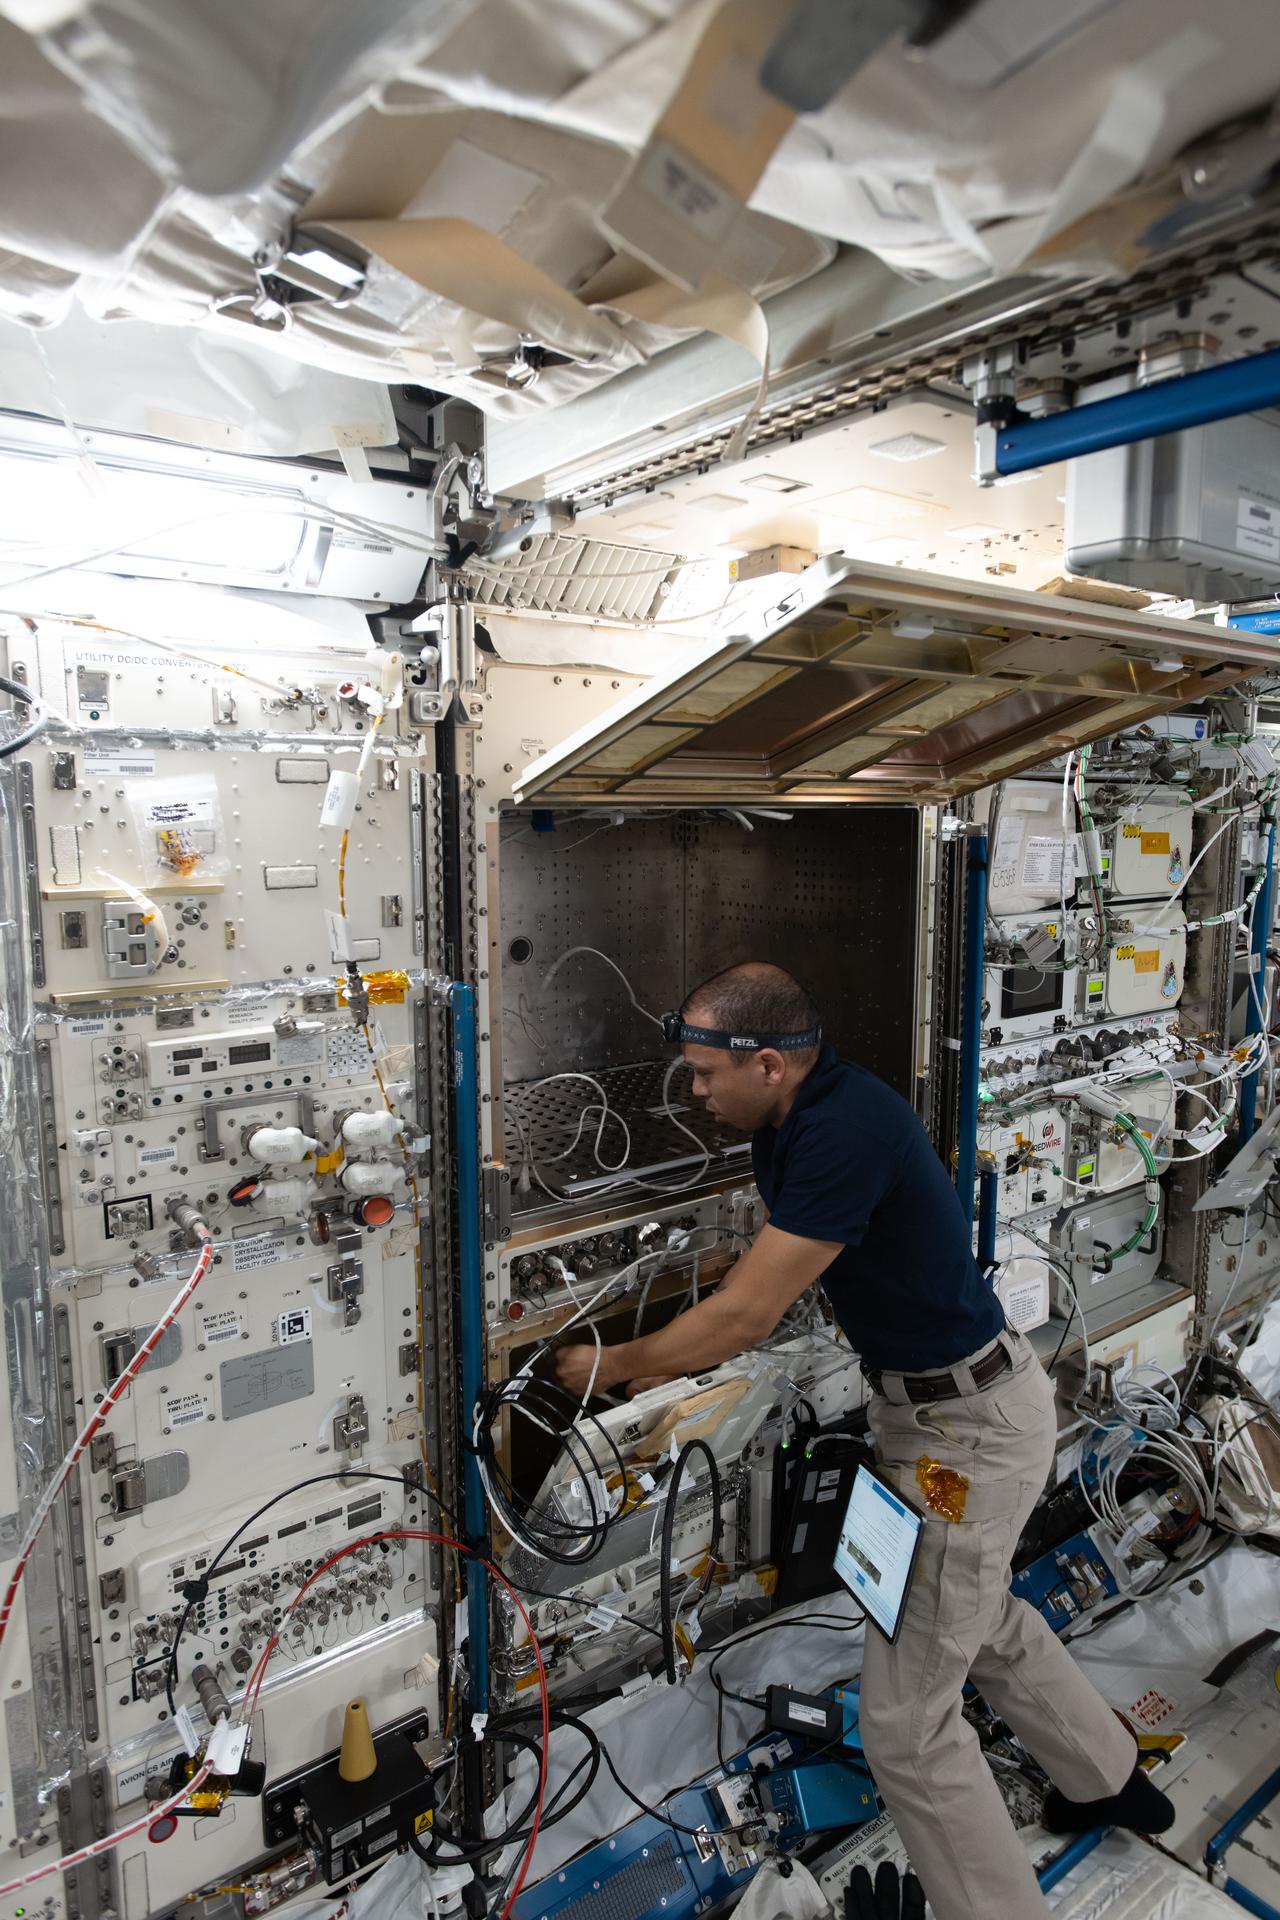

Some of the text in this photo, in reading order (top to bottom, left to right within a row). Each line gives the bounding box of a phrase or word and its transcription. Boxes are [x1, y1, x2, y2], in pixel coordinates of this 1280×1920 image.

[76, 652, 113, 663] UTILITY
[117, 655, 148, 665] DC/DC
[731, 1037, 758, 1048] PETZL
[1031, 1137, 1062, 1152] REDWIRE
[234, 1240, 285, 1256] CRYSTALLIZATION
[234, 1250, 275, 1264] OBSERVATION
[235, 1256, 280, 1271] FACILITY (SCOF)
[203, 1310, 235, 1323] SCOF PASS
[167, 1393, 199, 1407] SCOF PASS
[184, 1398, 202, 1409] PLATE
[119, 1763, 159, 1788] AVIONCS
[838, 1814, 888, 1855] MINUS EIGHTY
[862, 1832, 889, 1854] ELECTRONIC
